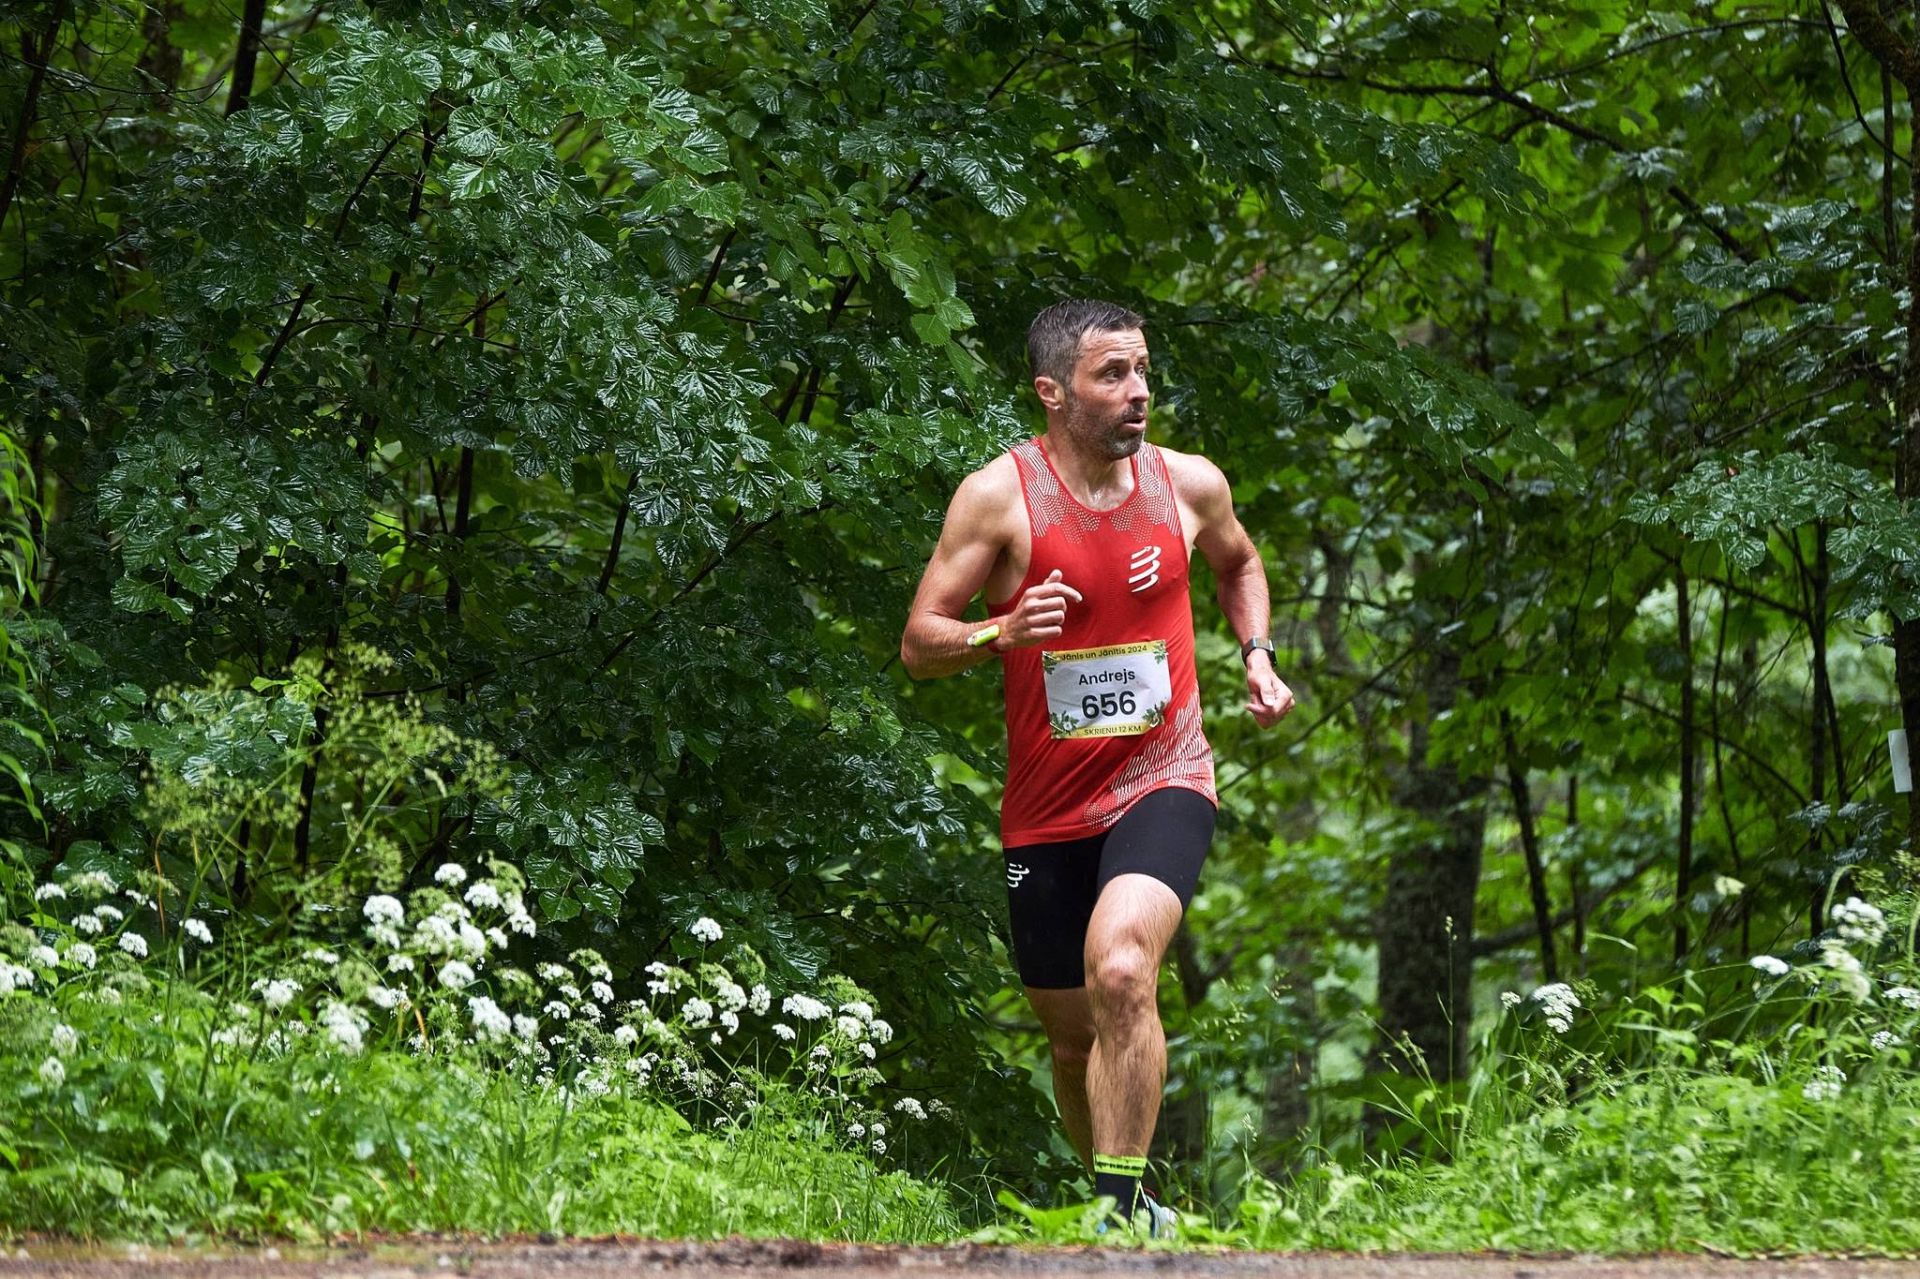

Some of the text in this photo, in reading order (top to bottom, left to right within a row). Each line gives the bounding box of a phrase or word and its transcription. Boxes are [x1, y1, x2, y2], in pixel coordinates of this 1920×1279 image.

[1127, 645, 1147, 654] 2024
[1078, 668, 1136, 686] Andrejs
[1081, 690, 1136, 719] 656
[1118, 725, 1127, 733] 12
